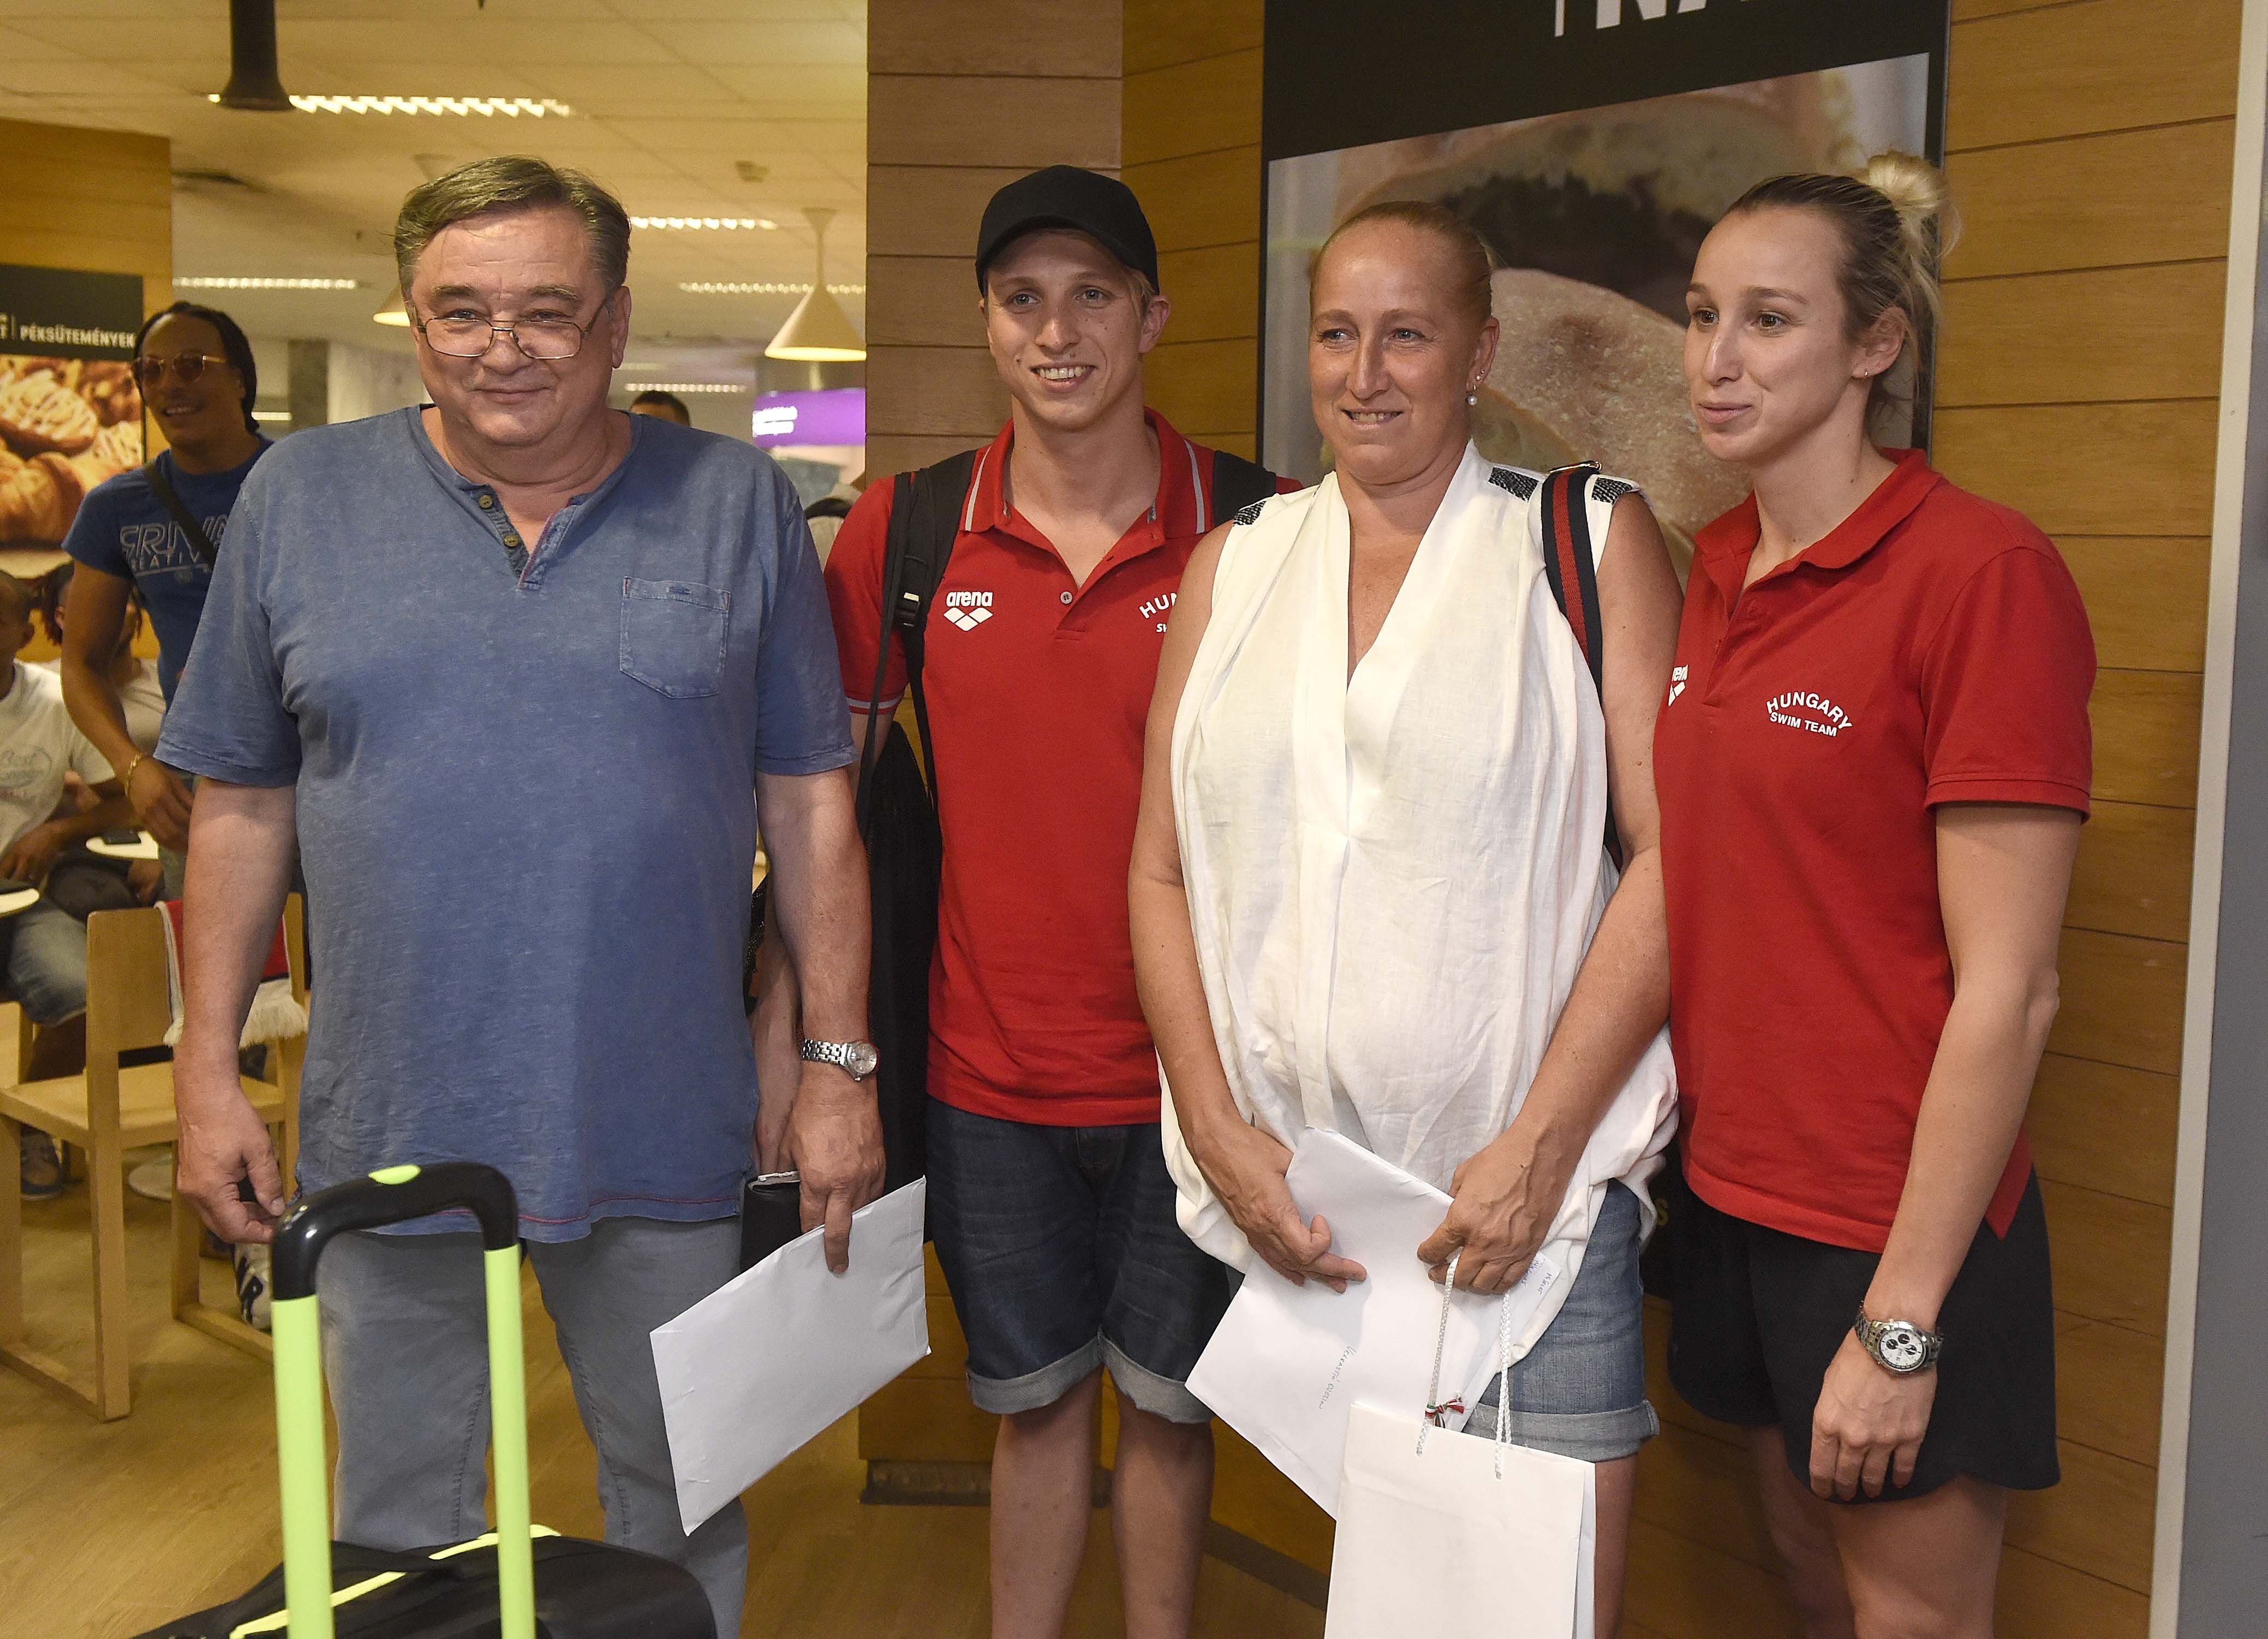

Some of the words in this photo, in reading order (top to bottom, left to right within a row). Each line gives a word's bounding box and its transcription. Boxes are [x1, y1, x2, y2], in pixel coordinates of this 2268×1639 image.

[20, 323, 136, 349] PÉKSÜTEMÉNYEK
[946, 591, 993, 607] arena
[1766, 691, 1853, 729] HUNGARY
[1770, 711, 1801, 728] SWIM
[1804, 720, 1837, 737] TEAM
